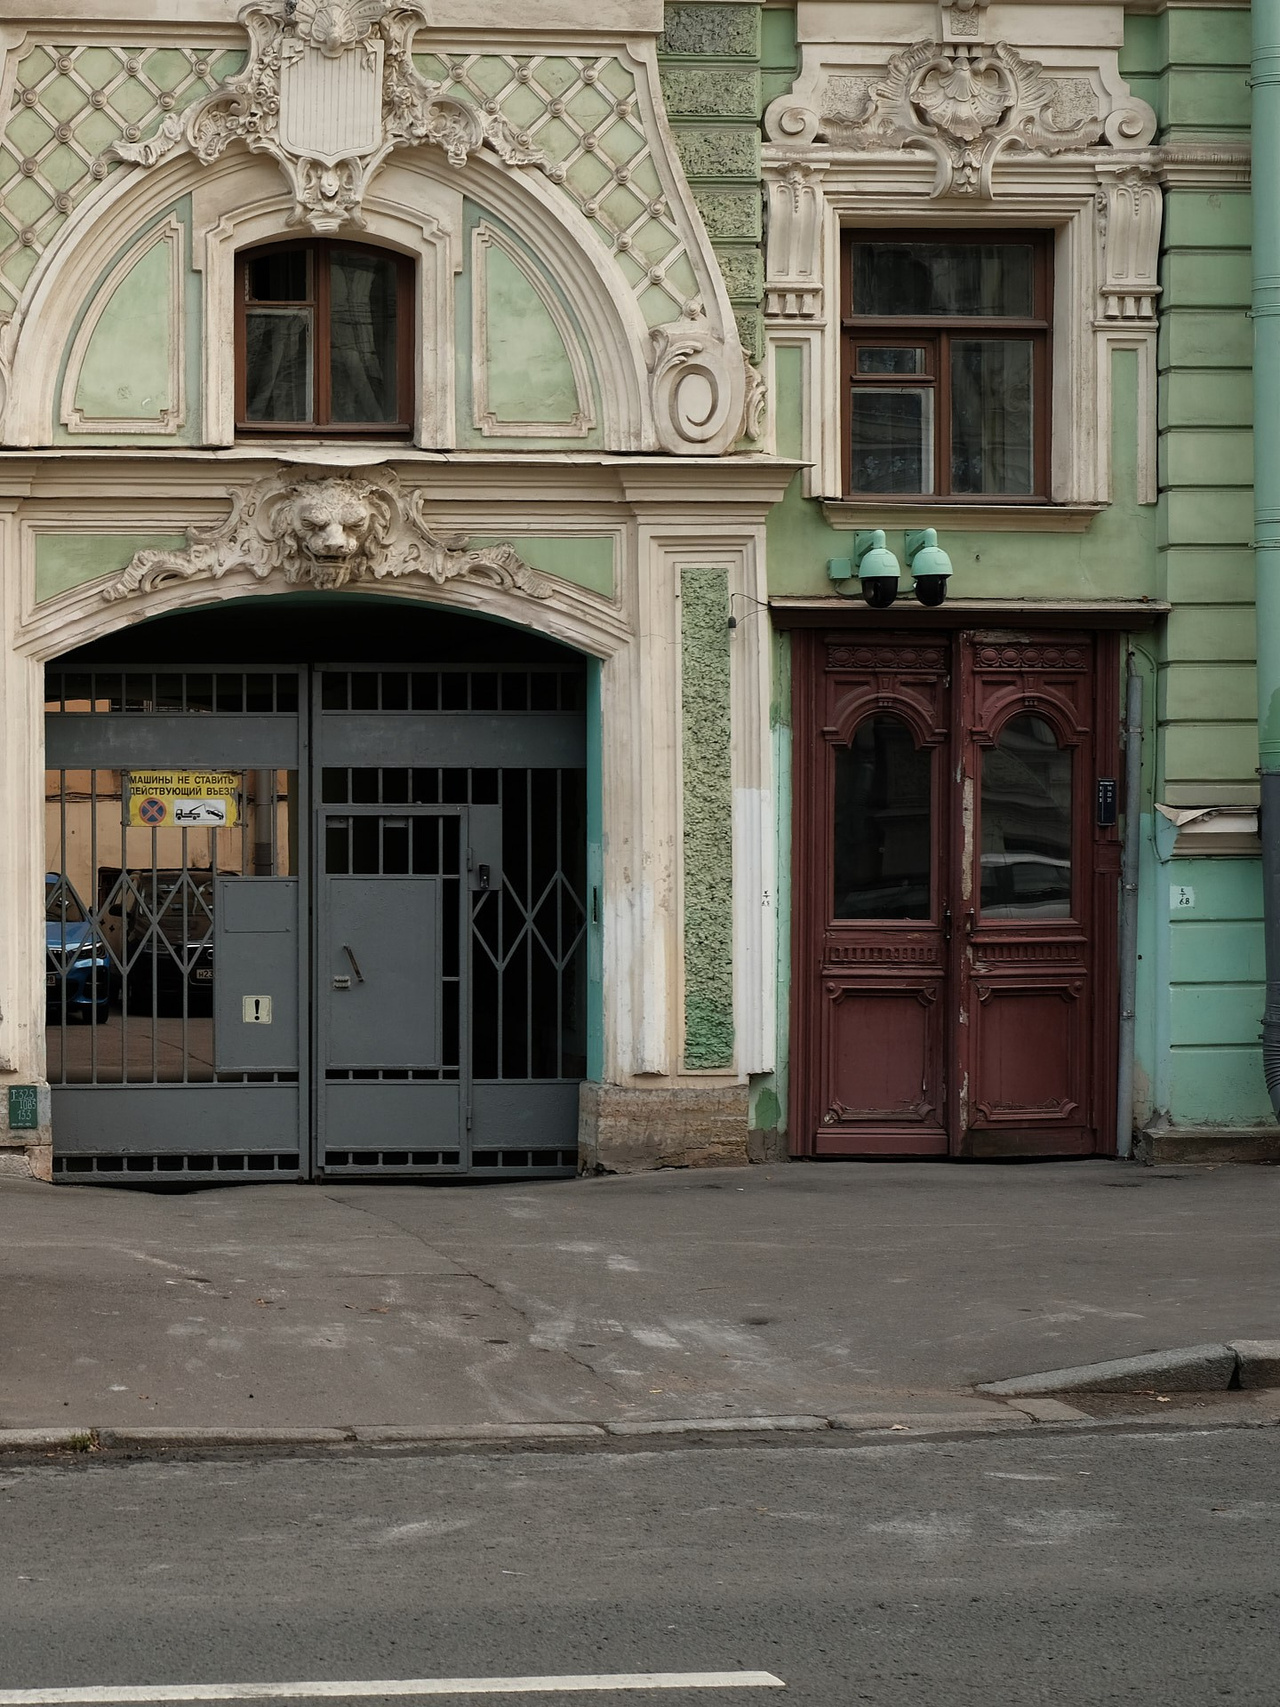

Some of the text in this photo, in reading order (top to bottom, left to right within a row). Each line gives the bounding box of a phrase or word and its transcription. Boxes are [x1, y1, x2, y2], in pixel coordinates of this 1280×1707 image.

[129, 775, 234, 785] МАШИНЫ НЕ СТАВИТЬ
[130, 785, 202, 796] ДЕЙСТВУЮЩИЙ
